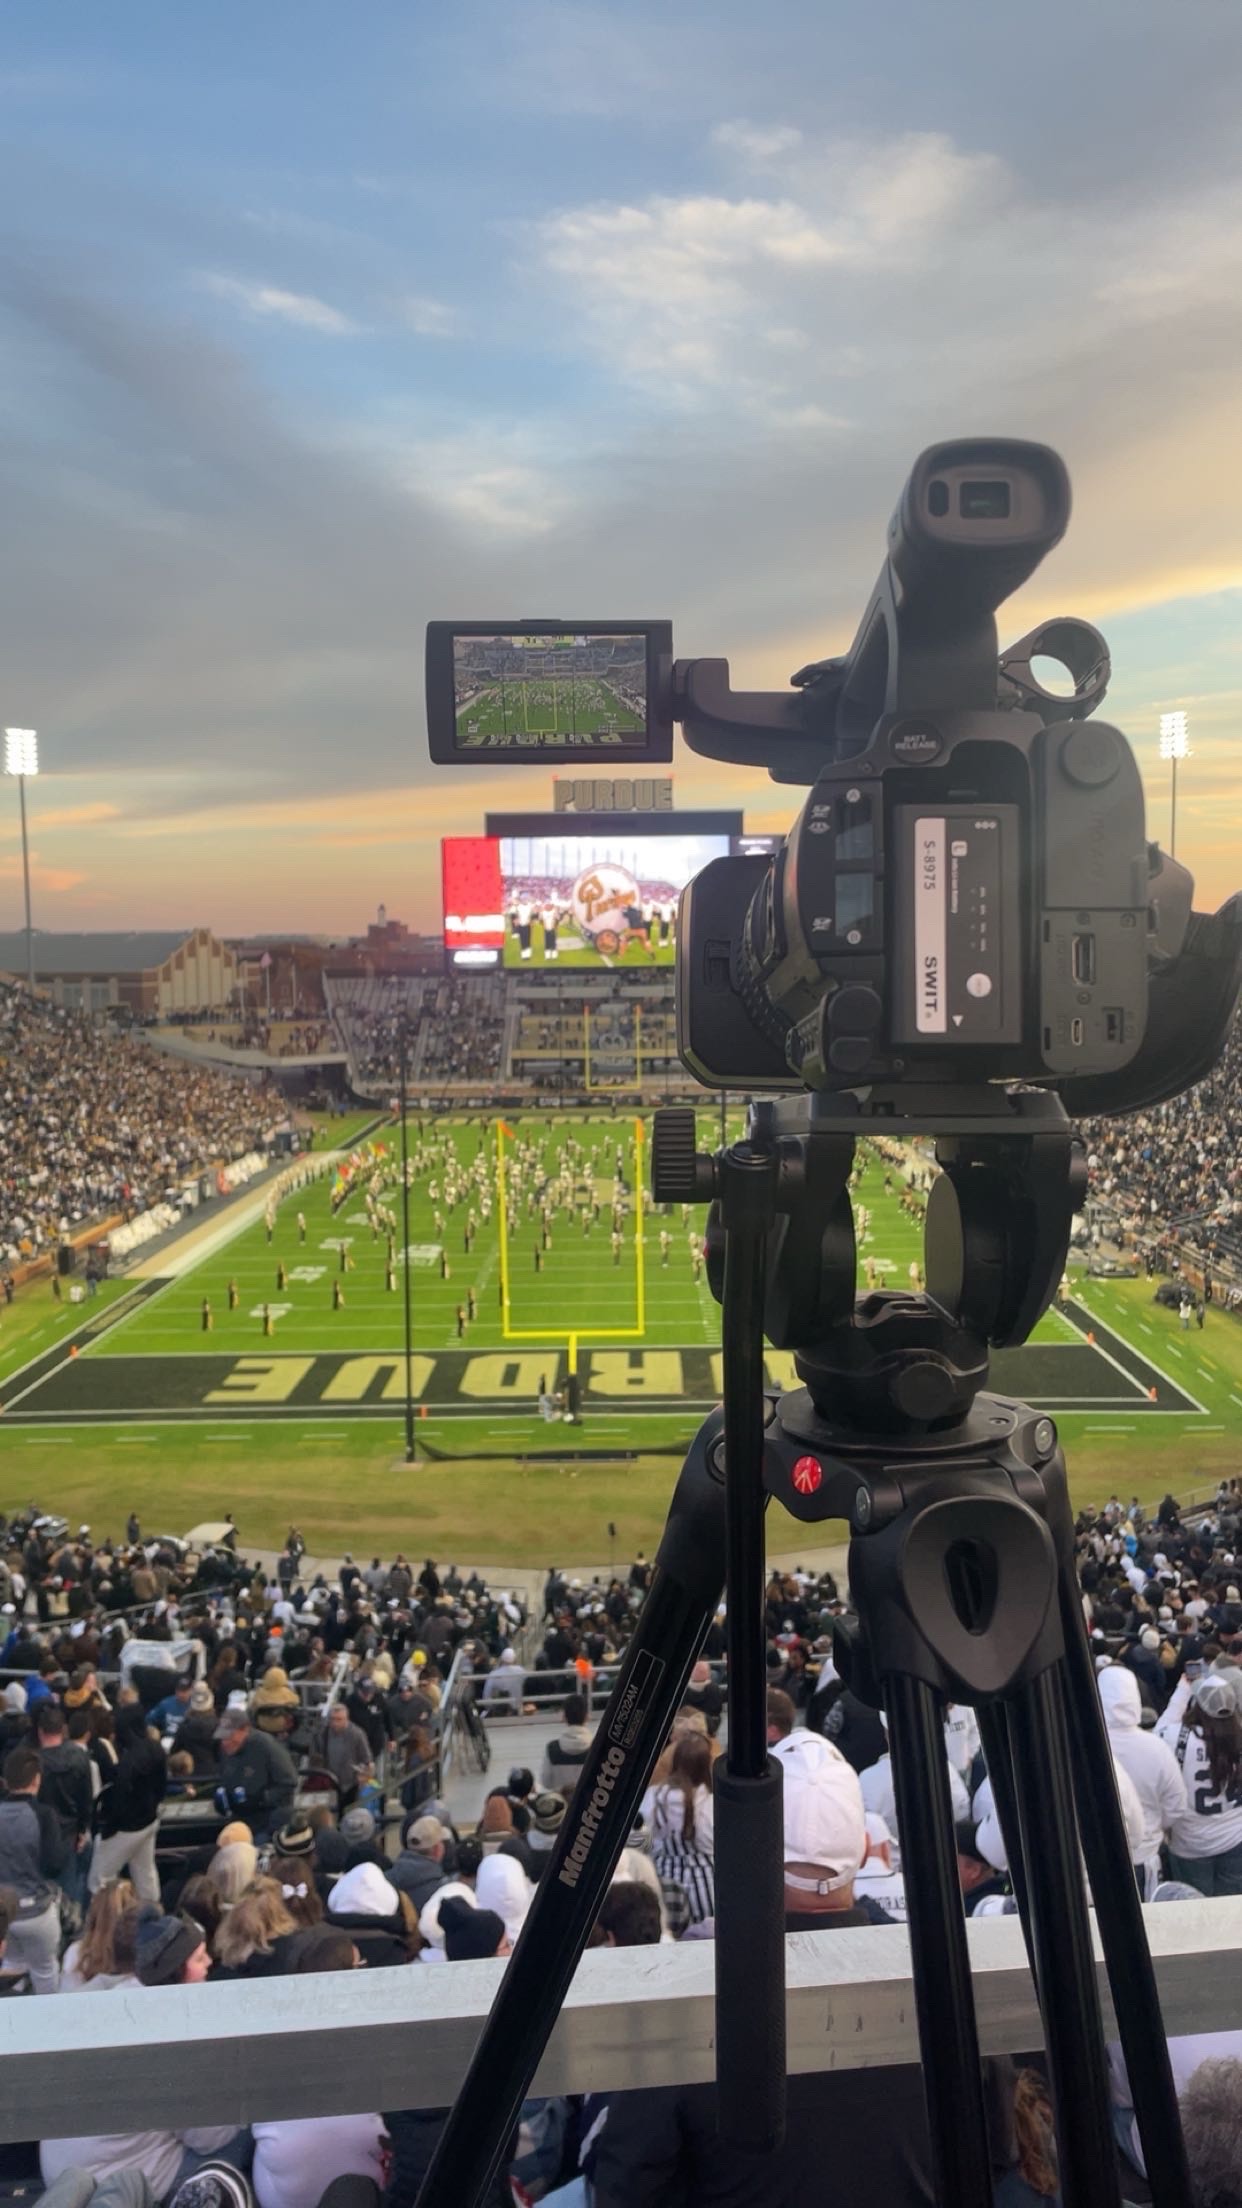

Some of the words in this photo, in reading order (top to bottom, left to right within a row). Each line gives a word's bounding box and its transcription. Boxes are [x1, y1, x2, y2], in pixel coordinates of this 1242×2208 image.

[895, 741, 937, 750] RELEASE
[553, 779, 673, 812] PURDUE
[923, 840, 936, 890] S-8975
[924, 956, 938, 1012] SWIT
[559, 1747, 625, 1888] Manfrotto
